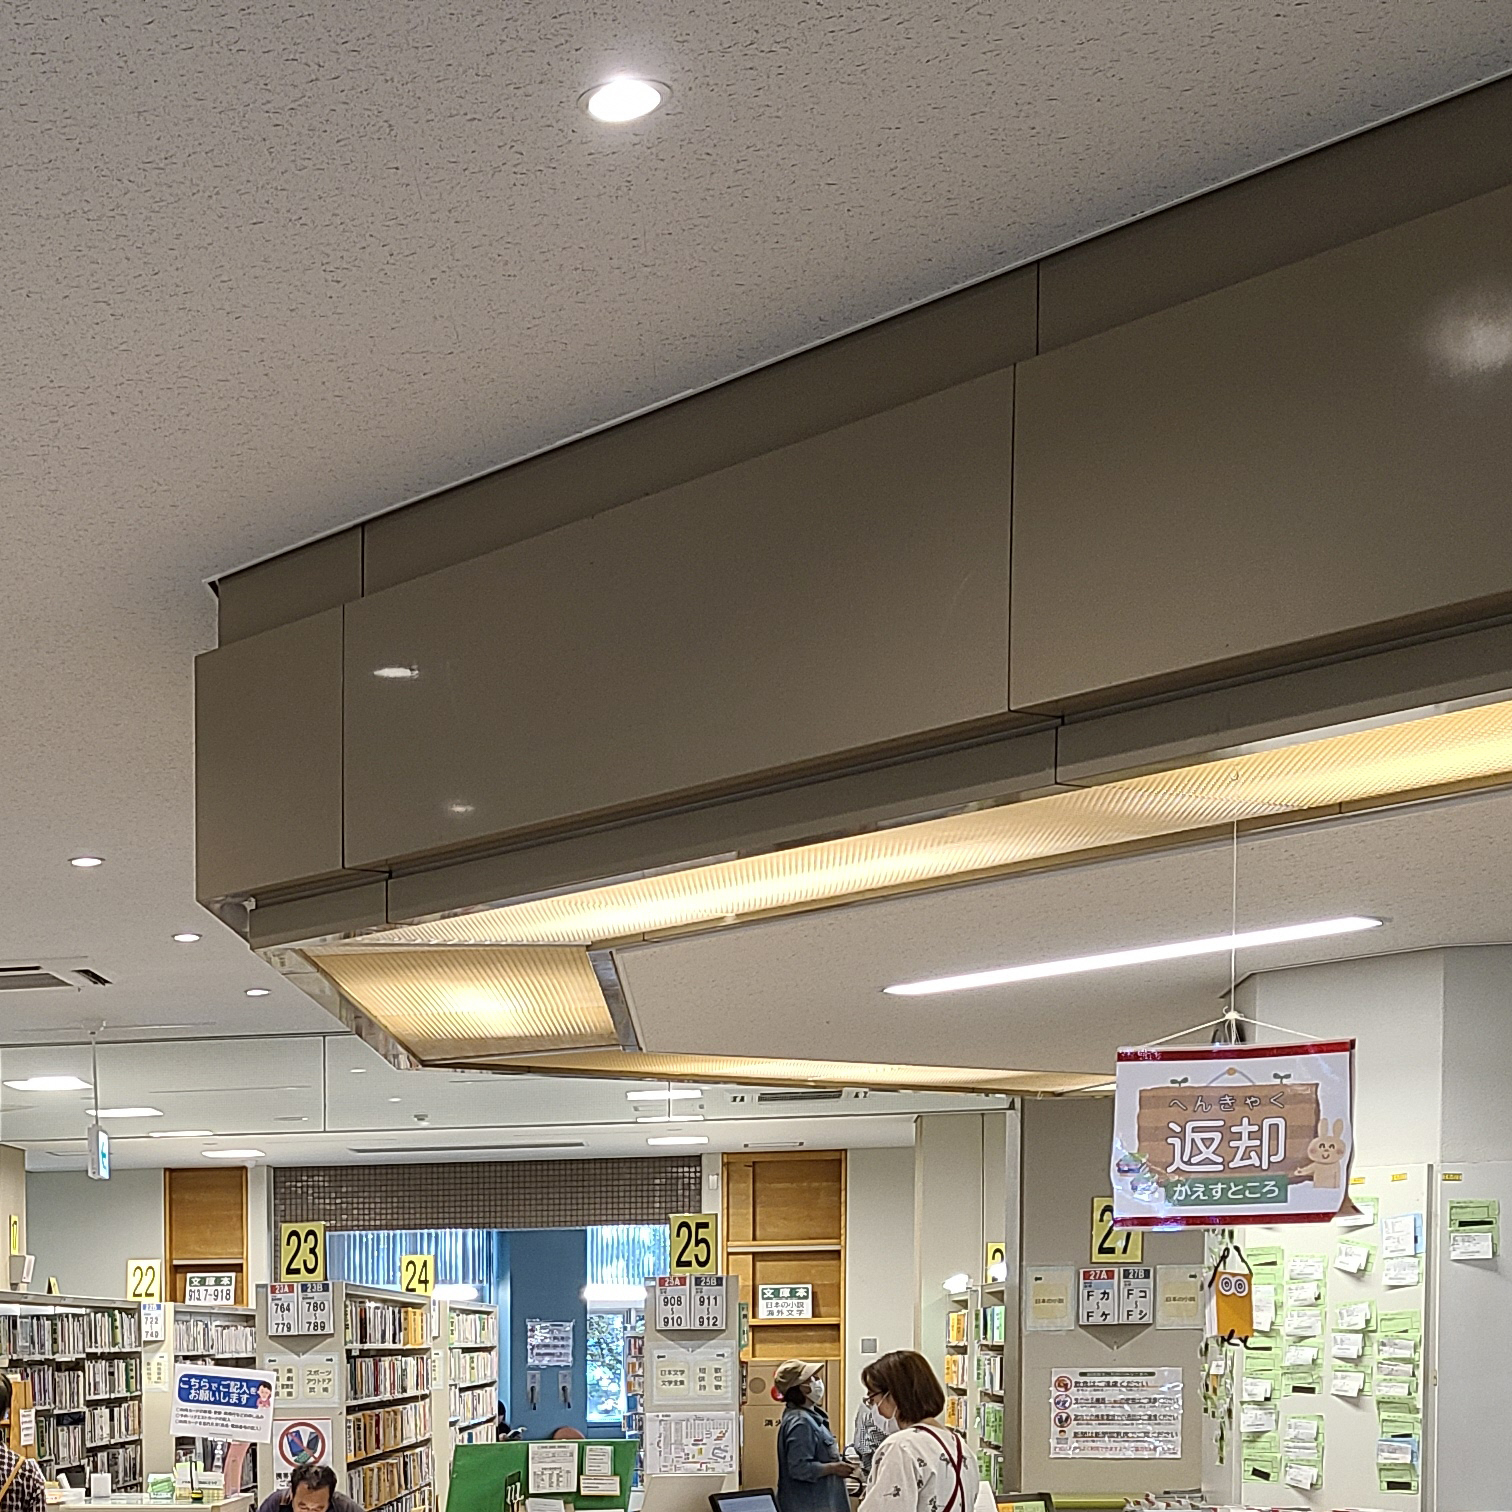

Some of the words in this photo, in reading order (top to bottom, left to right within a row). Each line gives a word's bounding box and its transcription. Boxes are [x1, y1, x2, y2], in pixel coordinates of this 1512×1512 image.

[1169, 1092, 1285, 1112] へんきゃく
[1166, 1117, 1287, 1174] 返却
[1173, 1181, 1280, 1200] かえすところ
[675, 1220, 711, 1268] 25
[285, 1229, 319, 1275] 23
[405, 1259, 429, 1293] 24
[1089, 1272, 1108, 1281] 27A
[1128, 1269, 1145, 1279] 27B
[132, 1265, 156, 1298] 22
[191, 1277, 231, 1286] 文庫本
[306, 1282, 324, 1293] 23B
[275, 1283, 289, 1294] 23A
[762, 1288, 808, 1298] 文庫本
[1126, 1289, 1134, 1299] F
[1138, 1289, 1147, 1299] コ
[663, 1295, 683, 1307] 908
[698, 1295, 718, 1307] 911
[1087, 1291, 1095, 1301] F
[1099, 1290, 1110, 1302] カ
[274, 1301, 291, 1314] 764
[305, 1301, 326, 1313] 780
[765, 1301, 805, 1309] 日本の小説
[1087, 1311, 1095, 1322] F
[1126, 1309, 1134, 1320] F
[1138, 1309, 1148, 1320] シ
[144, 1317, 159, 1325] 722
[305, 1320, 326, 1332] 789
[663, 1315, 683, 1328] 910
[698, 1315, 719, 1327] 912
[274, 1322, 292, 1333] 779
[189, 1389, 250, 1405] お願いします
